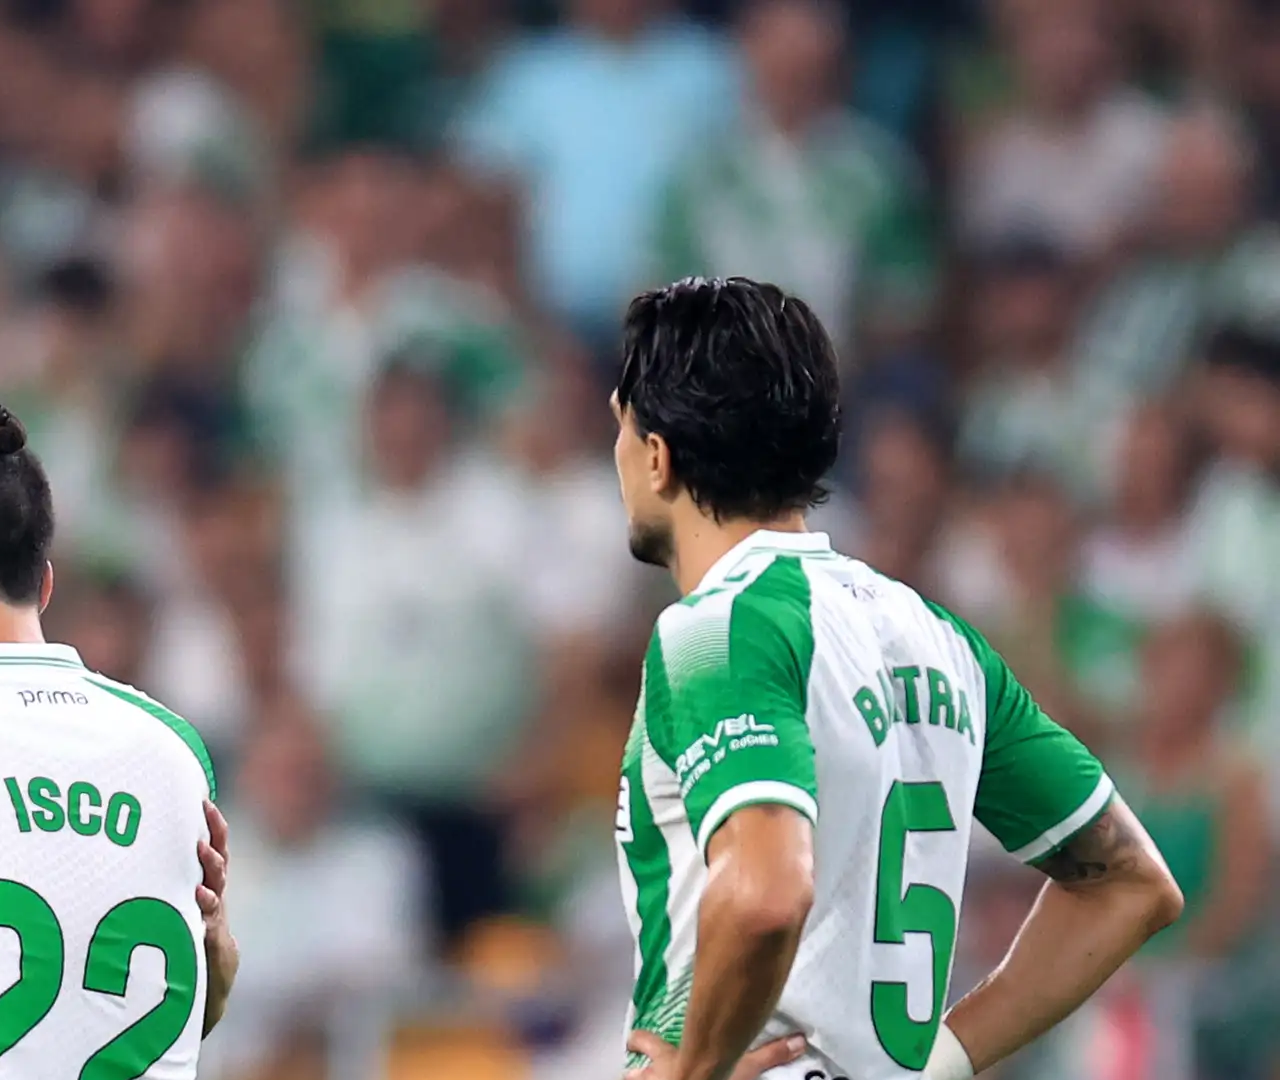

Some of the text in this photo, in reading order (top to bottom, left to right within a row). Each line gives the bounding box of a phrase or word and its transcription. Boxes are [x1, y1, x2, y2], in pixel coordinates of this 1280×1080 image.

[16, 690, 89, 708] prima
[3, 776, 141, 847] ISCO
[870, 779, 957, 1071] 5
